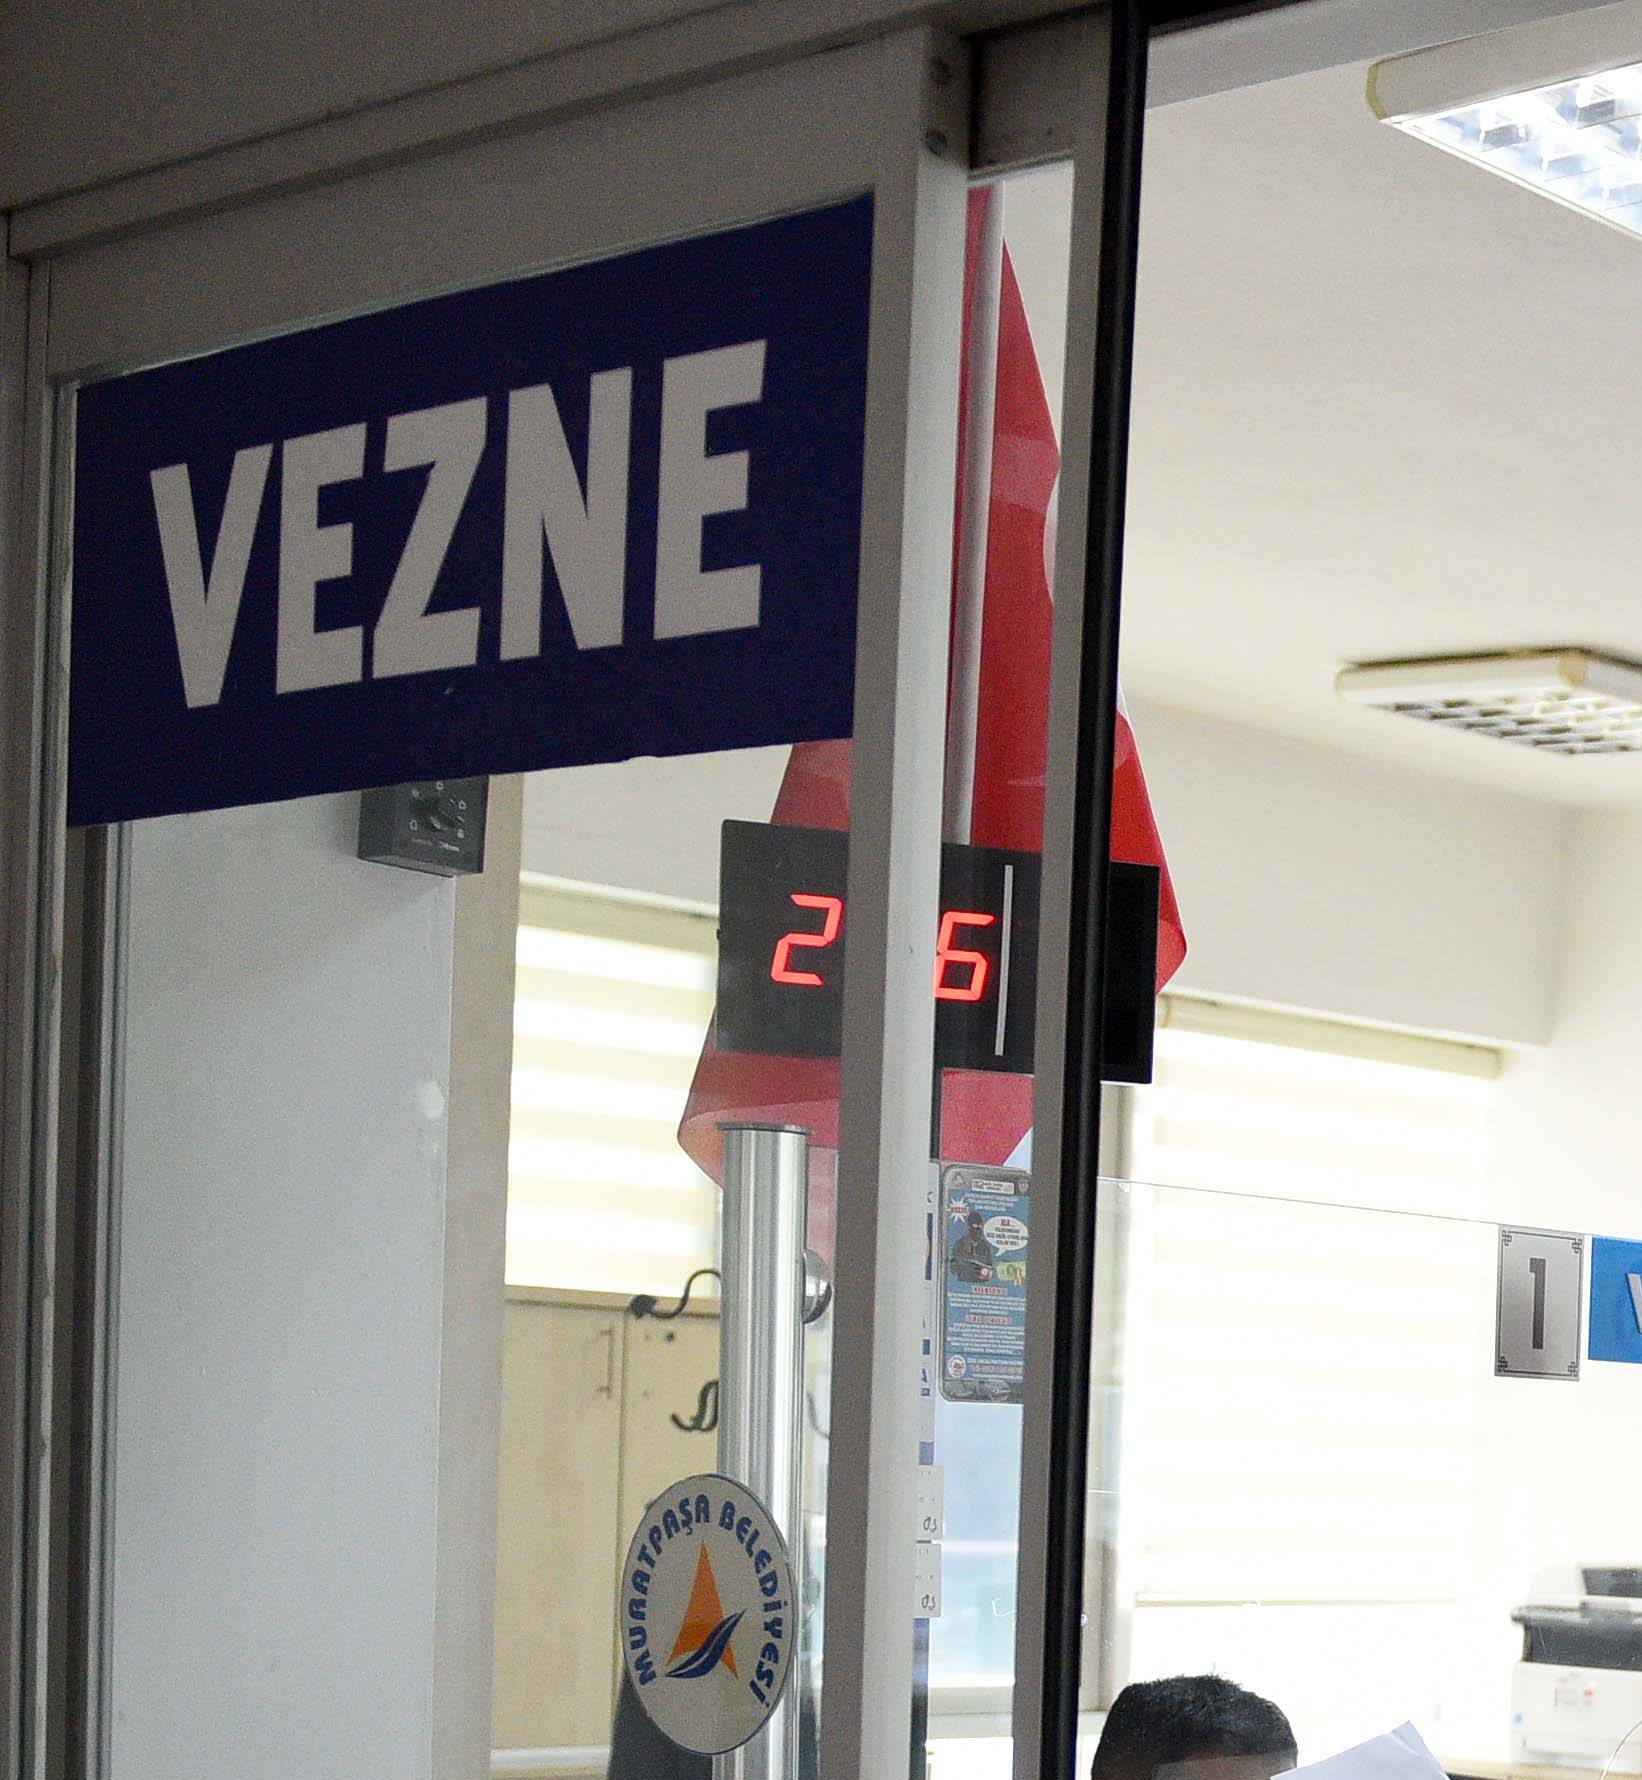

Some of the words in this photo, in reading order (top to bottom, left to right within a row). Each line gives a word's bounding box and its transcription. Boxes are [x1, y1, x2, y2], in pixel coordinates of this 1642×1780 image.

[150, 340, 767, 708] VEZNE
[770, 894, 995, 1001] 26
[1528, 1256, 1547, 1350] 1
[628, 1494, 710, 1686] MURATPAŞA
[719, 1501, 788, 1708] BELEDİYESİ
